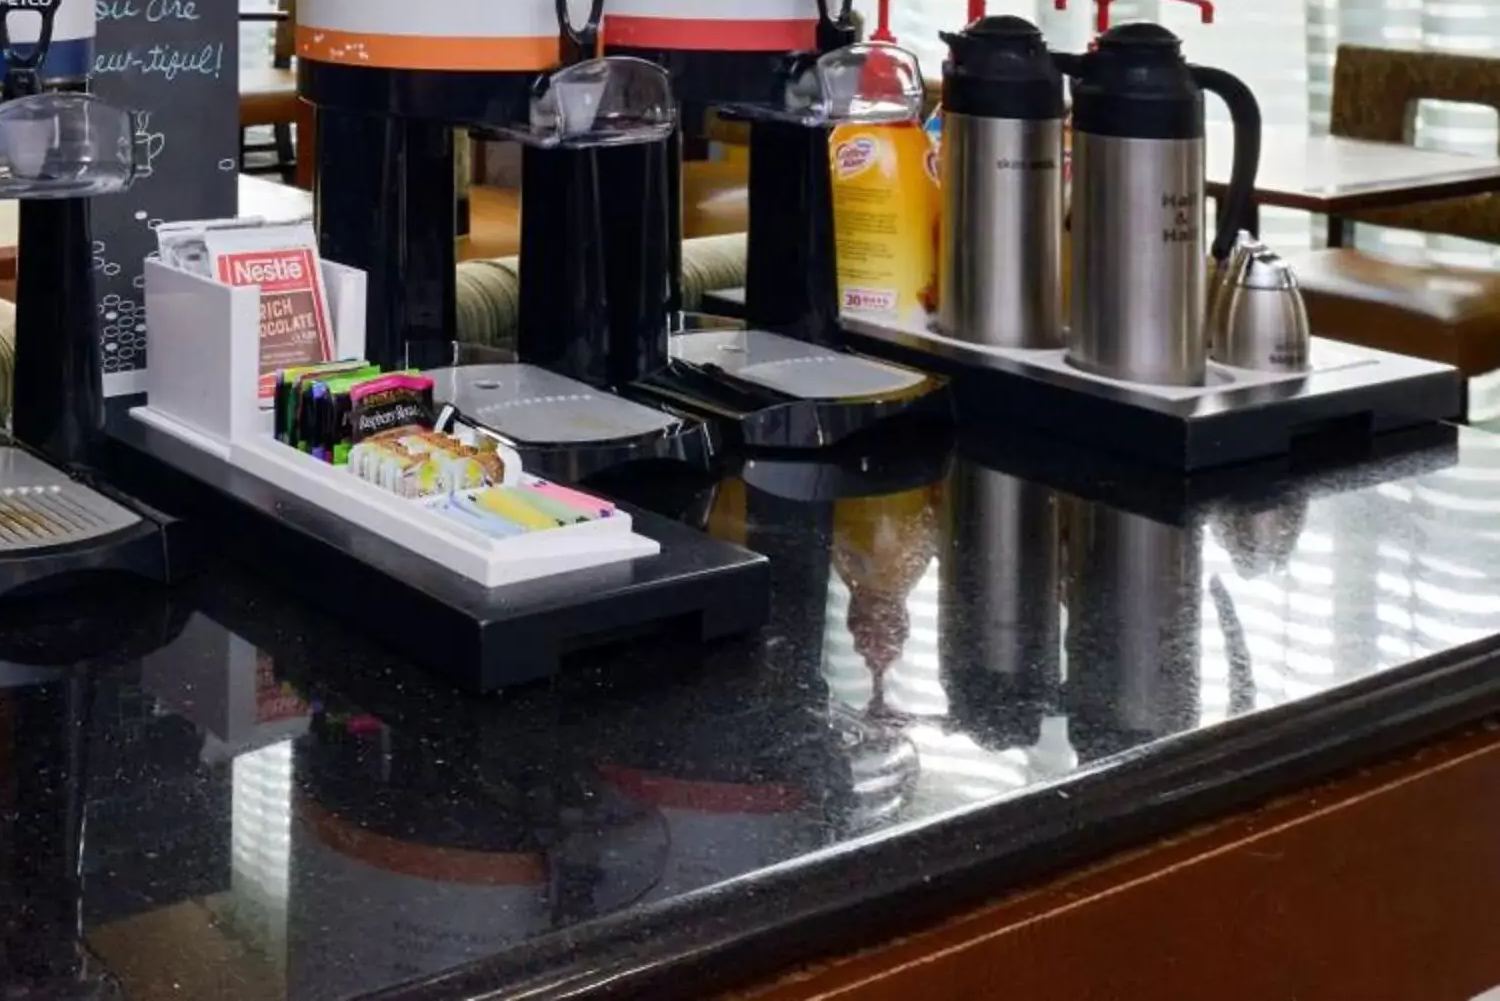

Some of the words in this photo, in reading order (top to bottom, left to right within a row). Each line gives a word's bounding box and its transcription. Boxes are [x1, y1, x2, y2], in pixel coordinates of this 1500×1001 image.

[95, 0, 141, 20] ou
[92, 42, 223, 80] ew-tiful!
[260, 312, 315, 338] OCOLATE
